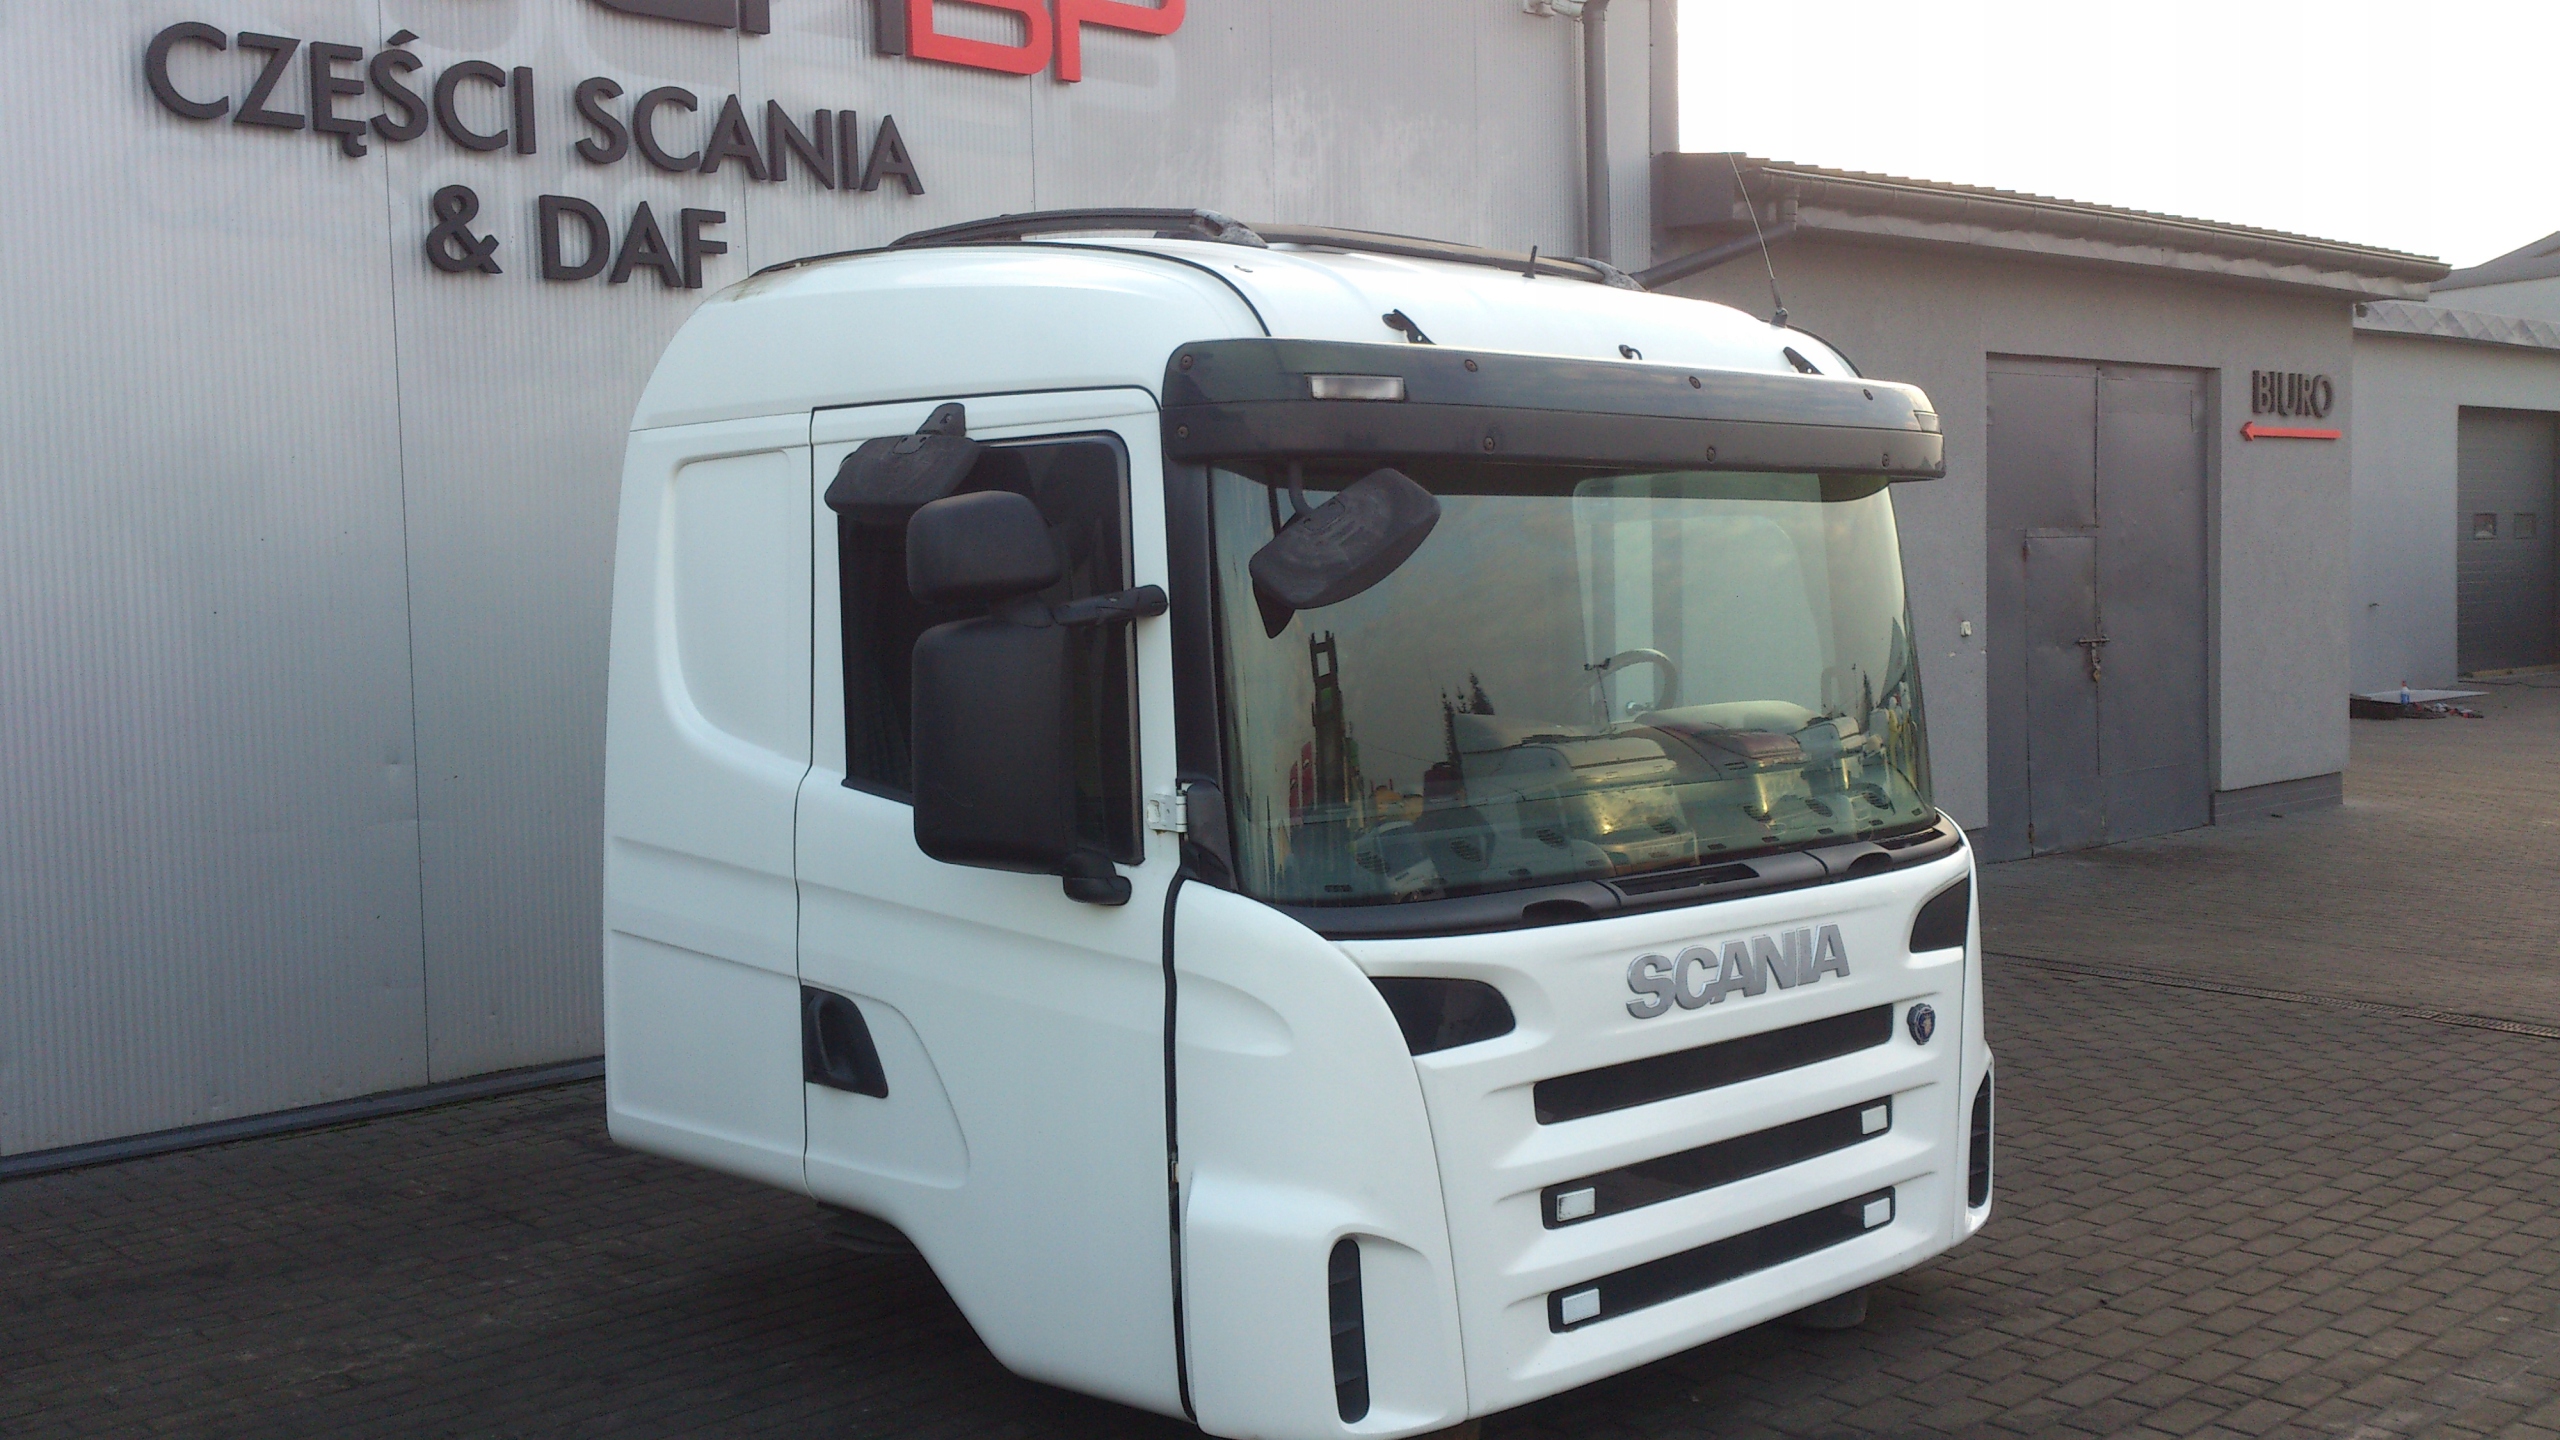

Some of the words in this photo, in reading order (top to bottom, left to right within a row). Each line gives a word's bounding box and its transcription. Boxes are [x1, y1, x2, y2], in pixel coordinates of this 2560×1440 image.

[145, 22, 537, 160] CZĘŚCI
[574, 77, 925, 197] SCANIA
[424, 185, 501, 276] &
[539, 195, 727, 290] DAF
[2252, 370, 2336, 418] BIURO
[1626, 922, 1850, 1020] SCANIA
